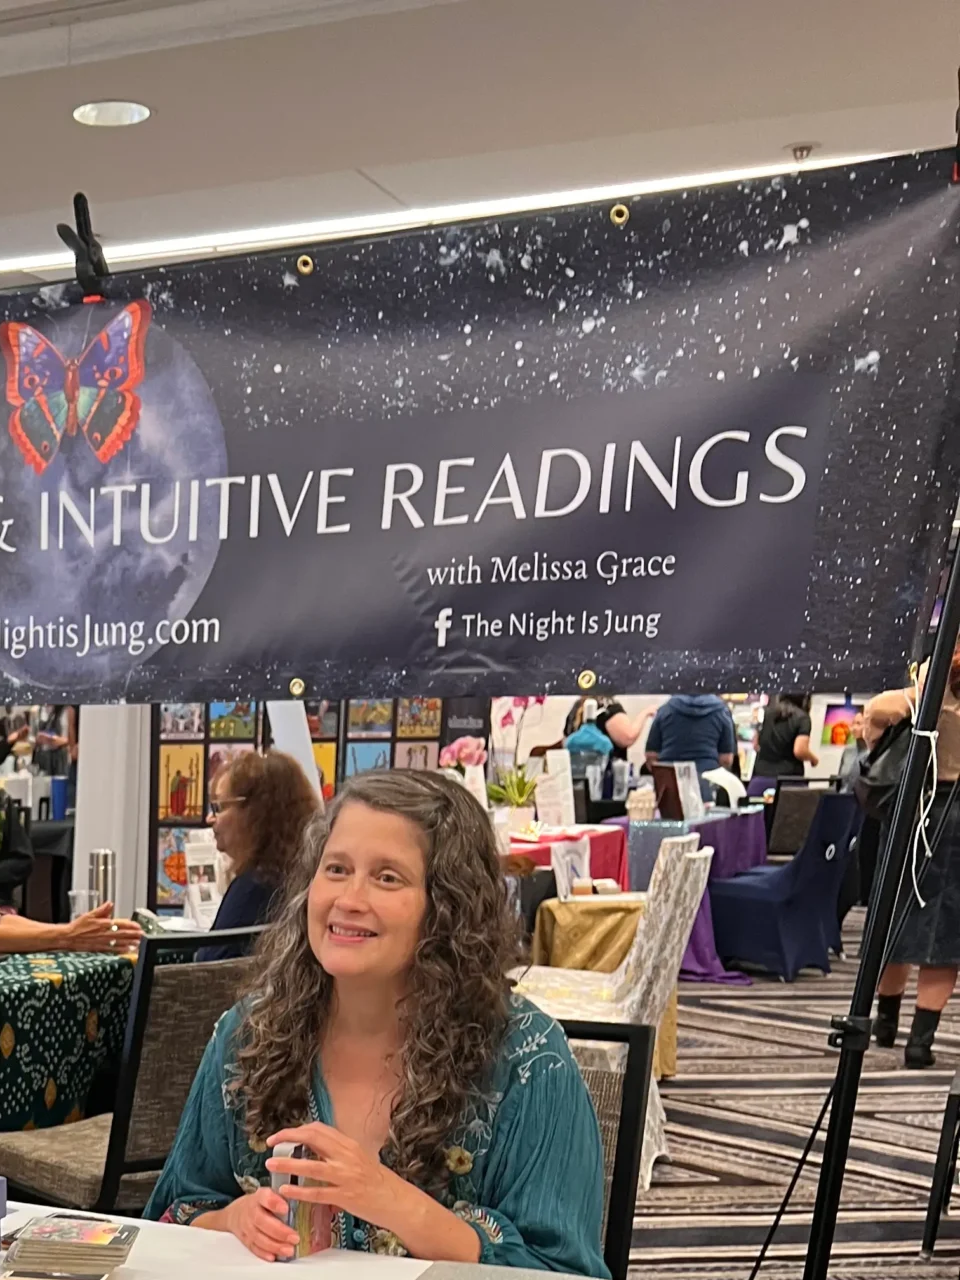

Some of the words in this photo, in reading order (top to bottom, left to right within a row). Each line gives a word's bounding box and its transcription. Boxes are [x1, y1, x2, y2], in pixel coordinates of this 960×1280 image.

[40, 468, 354, 552] INTUITIVE
[381, 425, 808, 531] READINGS
[426, 557, 482, 587] with
[490, 554, 588, 584] Melissa
[596, 551, 676, 586] Grace
[461, 614, 503, 639] The
[508, 610, 575, 640] Night
[580, 610, 599, 635] Is
[603, 609, 661, 639] Jung
